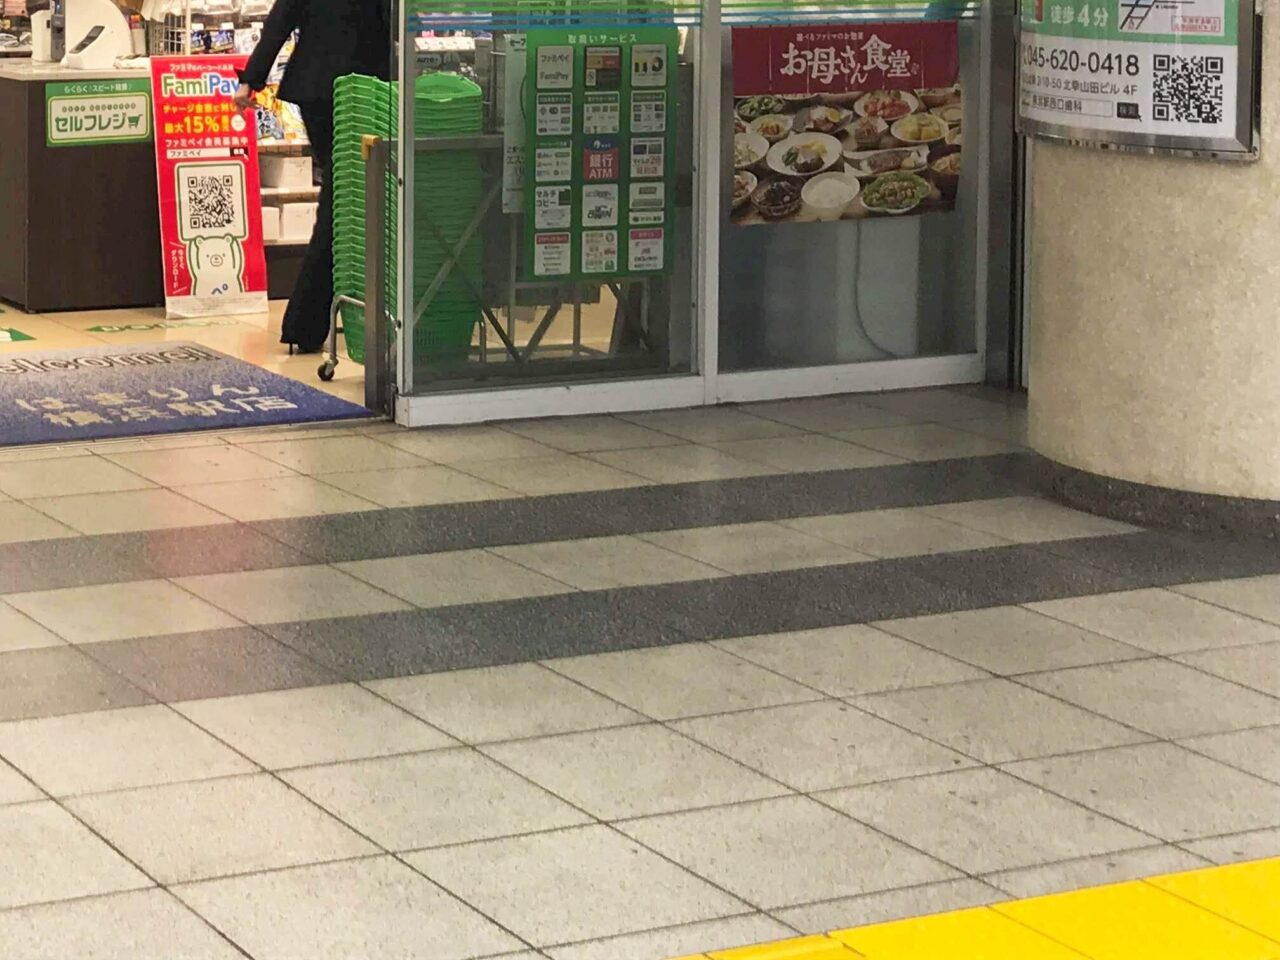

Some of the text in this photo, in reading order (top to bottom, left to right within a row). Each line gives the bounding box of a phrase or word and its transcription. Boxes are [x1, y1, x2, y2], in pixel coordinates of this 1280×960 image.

[1050, 4, 1109, 28] 徒歩4分
[779, 33, 912, 85] お母さん食堂
[1122, 84, 1138, 96] 4F
[55, 112, 127, 133] セルフレジ
[170, 149, 202, 157] ファミペイ
[589, 153, 614, 168] 銀行
[588, 168, 614, 179] ATM
[536, 190, 557, 198] マルチ
[536, 200, 557, 208] コピー
